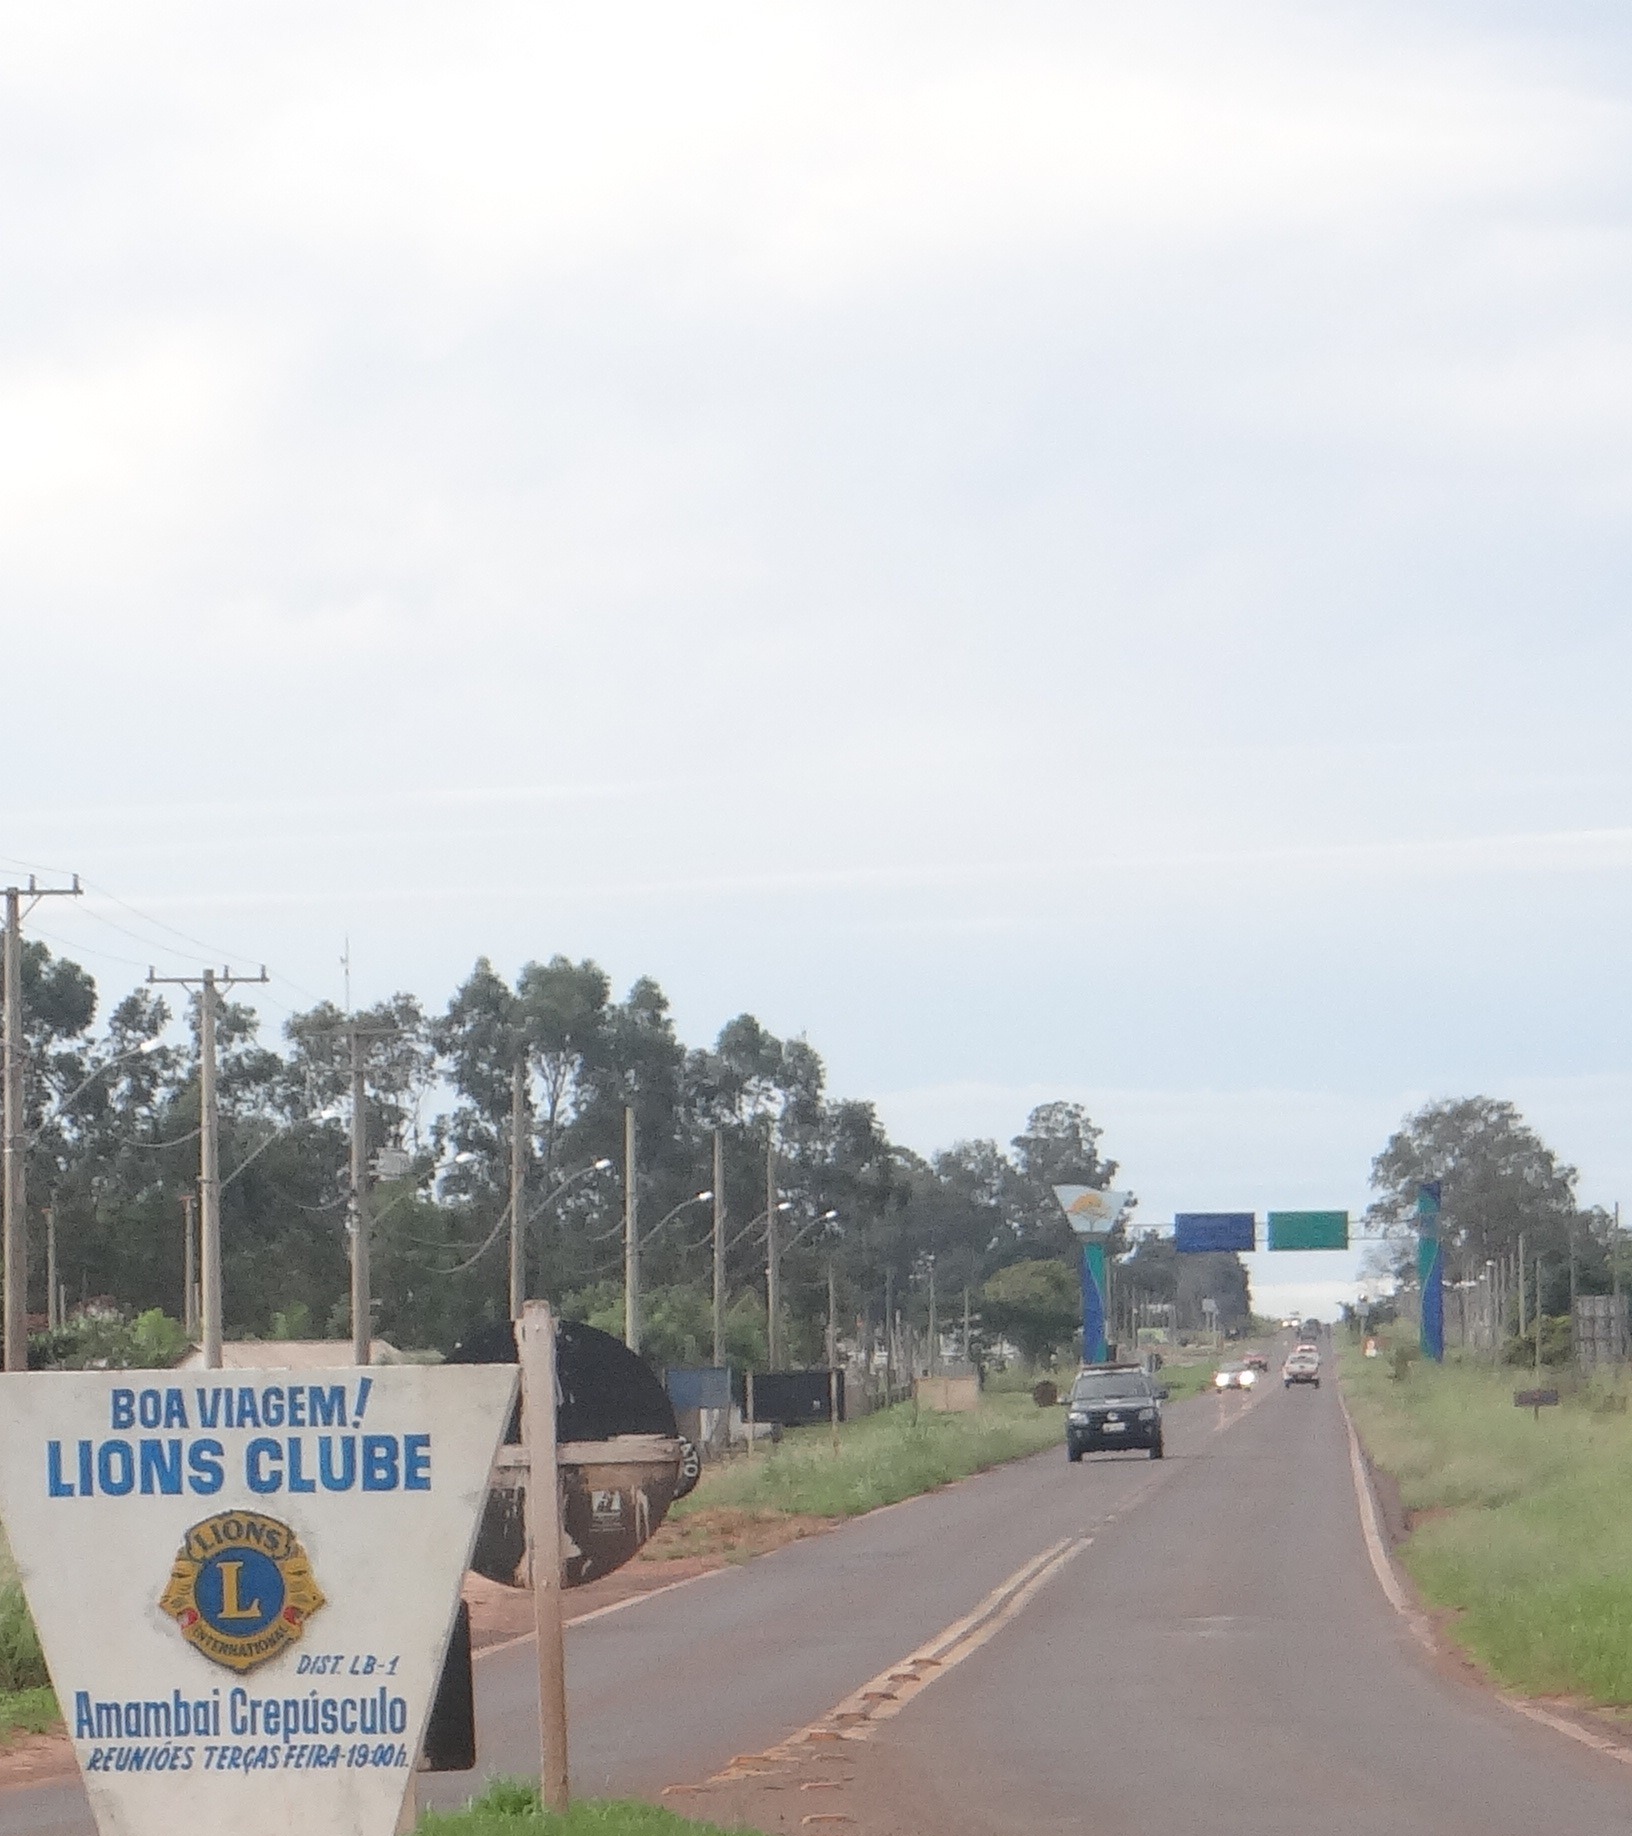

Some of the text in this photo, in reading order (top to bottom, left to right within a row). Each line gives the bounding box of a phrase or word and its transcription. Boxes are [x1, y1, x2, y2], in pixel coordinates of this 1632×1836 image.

[111, 1376, 373, 1430] BOA VIAGEM!
[47, 1434, 431, 1497] LIONS CLUBE
[193, 1519, 282, 1551] LIONS
[216, 1560, 262, 1619] L
[348, 1655, 401, 1675] LB-1
[75, 1686, 407, 1743] Amambai Crepúsculo
[87, 1741, 195, 1772] REUNIÕES
[204, 1744, 281, 1774] TERÇAS
